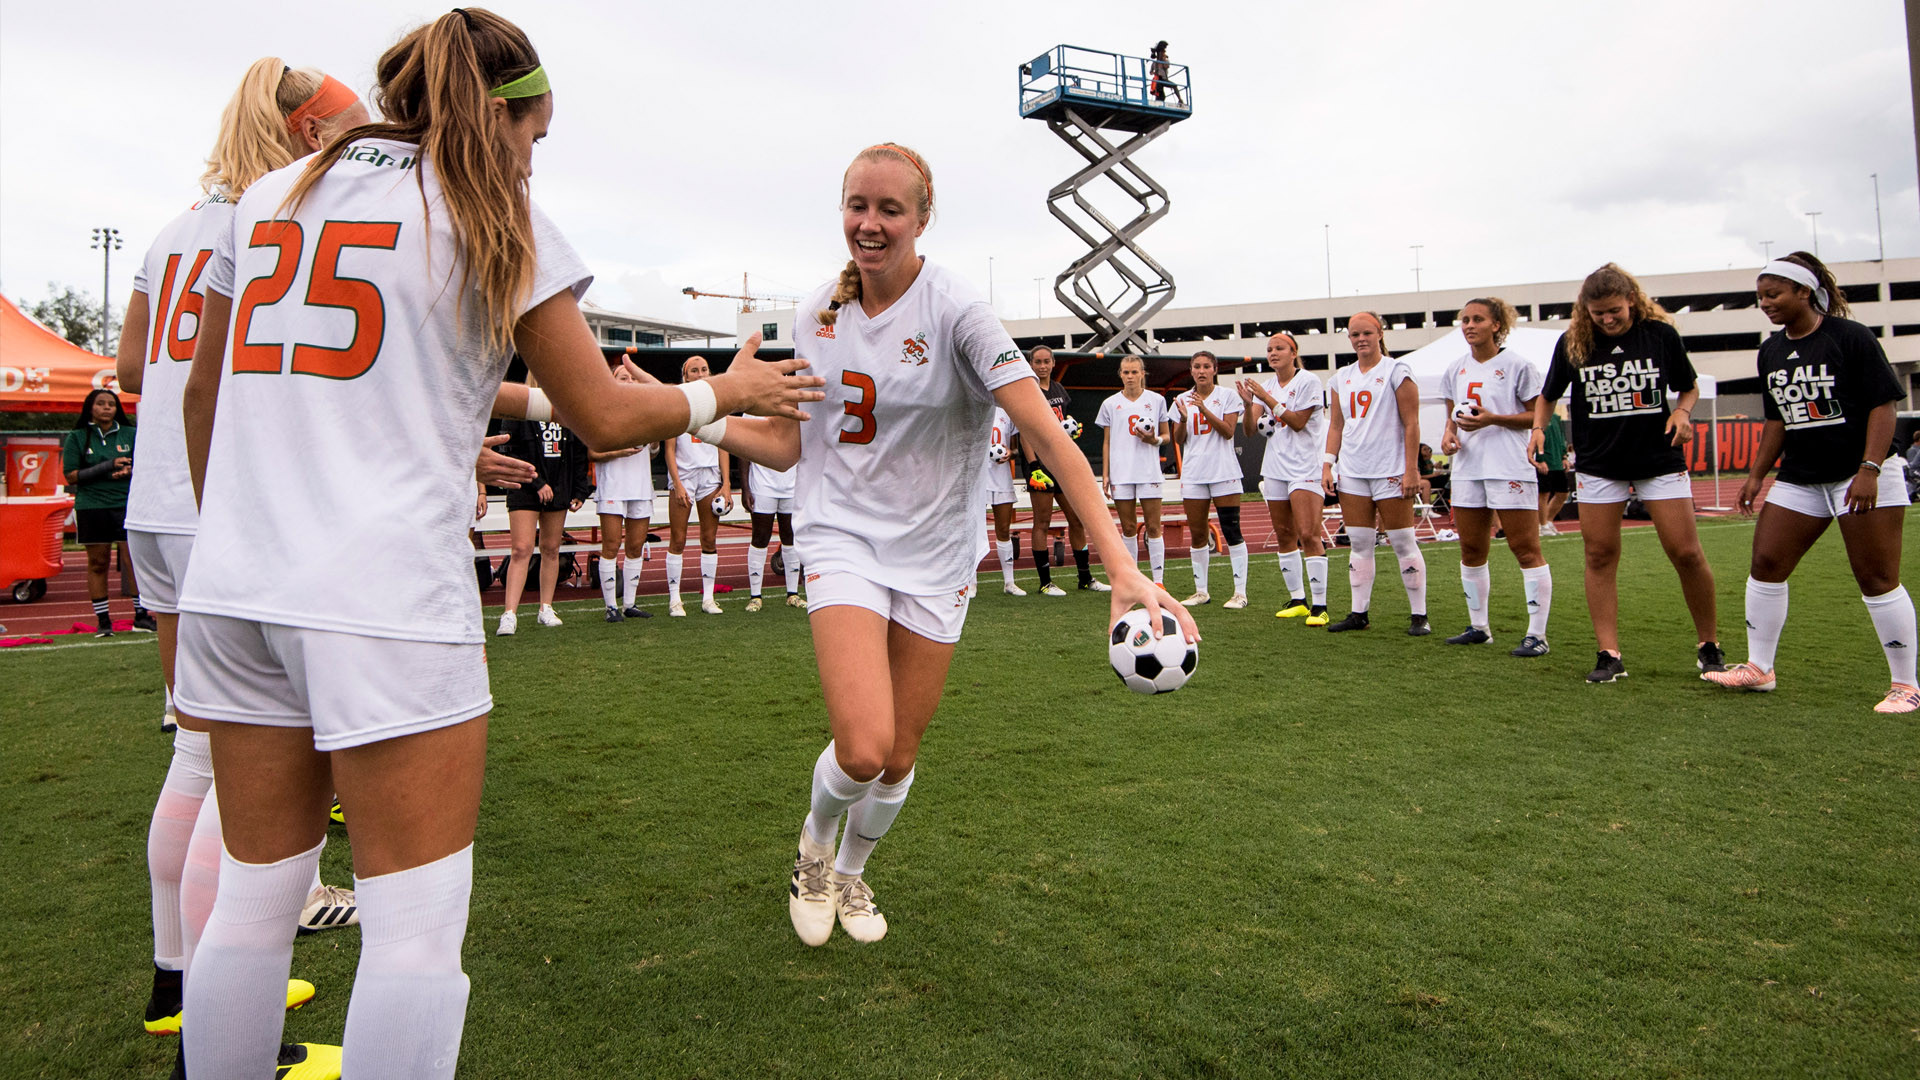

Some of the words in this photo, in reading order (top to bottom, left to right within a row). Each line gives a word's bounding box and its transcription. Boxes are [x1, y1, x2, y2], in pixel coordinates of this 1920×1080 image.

[150, 249, 214, 364] 16
[232, 219, 402, 380] 25
[992, 349, 1021, 367] ACC
[1579, 362, 1618, 383] IT'S
[1621, 358, 1660, 376] ALL
[1585, 373, 1660, 397] ABOUT
[1792, 363, 1835, 384] ALL
[1350, 390, 1373, 419] 19
[1467, 382, 1483, 407] 5
[1769, 381, 1835, 405] BOUT
[839, 369, 877, 445] 3
[21, 453, 39, 470] G
